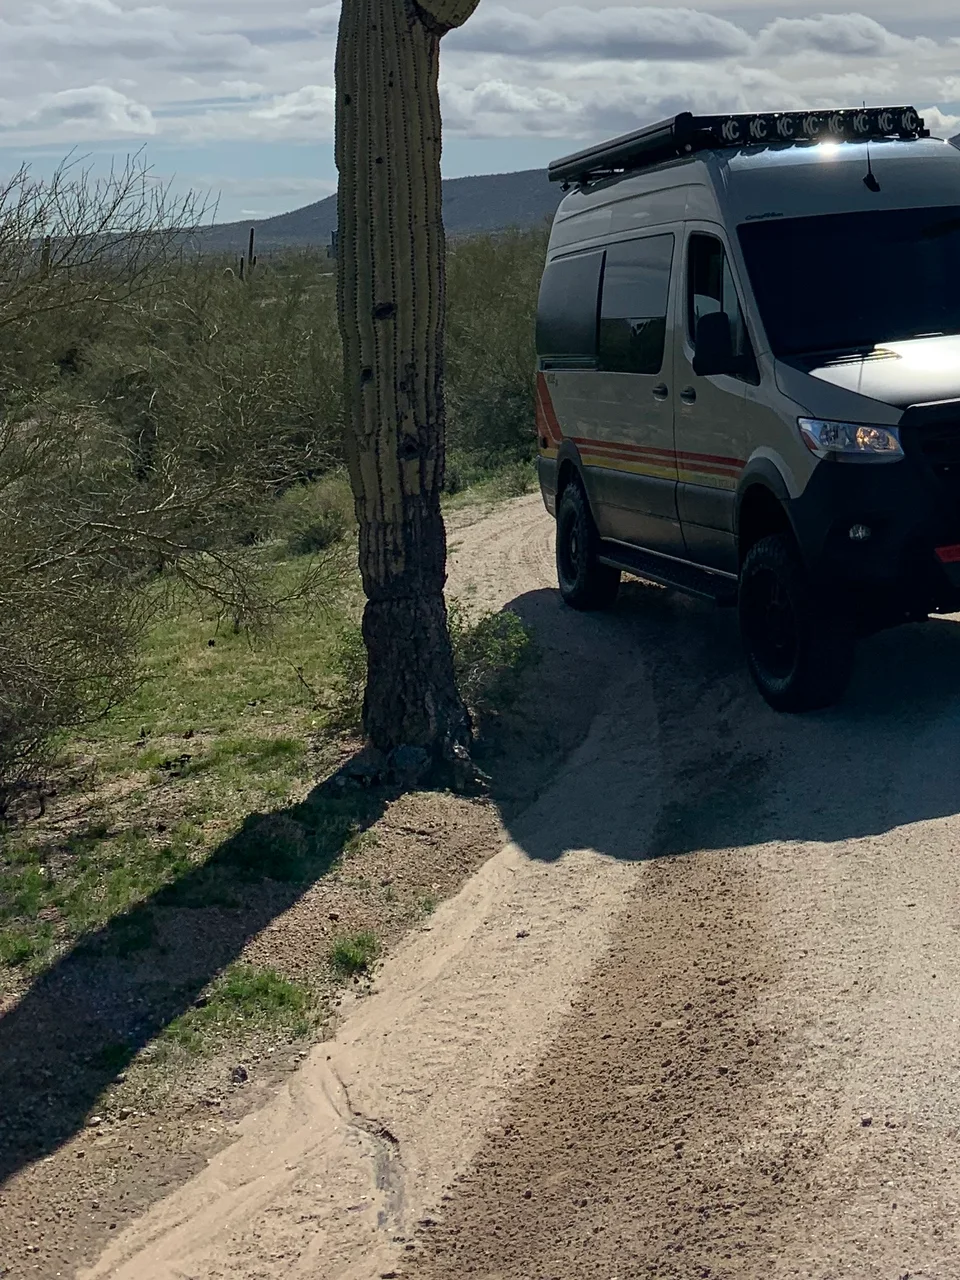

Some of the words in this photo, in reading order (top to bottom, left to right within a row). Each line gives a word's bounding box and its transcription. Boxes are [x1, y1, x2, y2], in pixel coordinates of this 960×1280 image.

[722, 120, 739, 140] KC
[749, 118, 766, 138] KC
[777, 116, 793, 136] KC
[802, 115, 819, 135] KC
[828, 114, 844, 134] KC
[853, 112, 869, 132] KC
[878, 111, 893, 131] KC
[901, 110, 917, 130] KC
